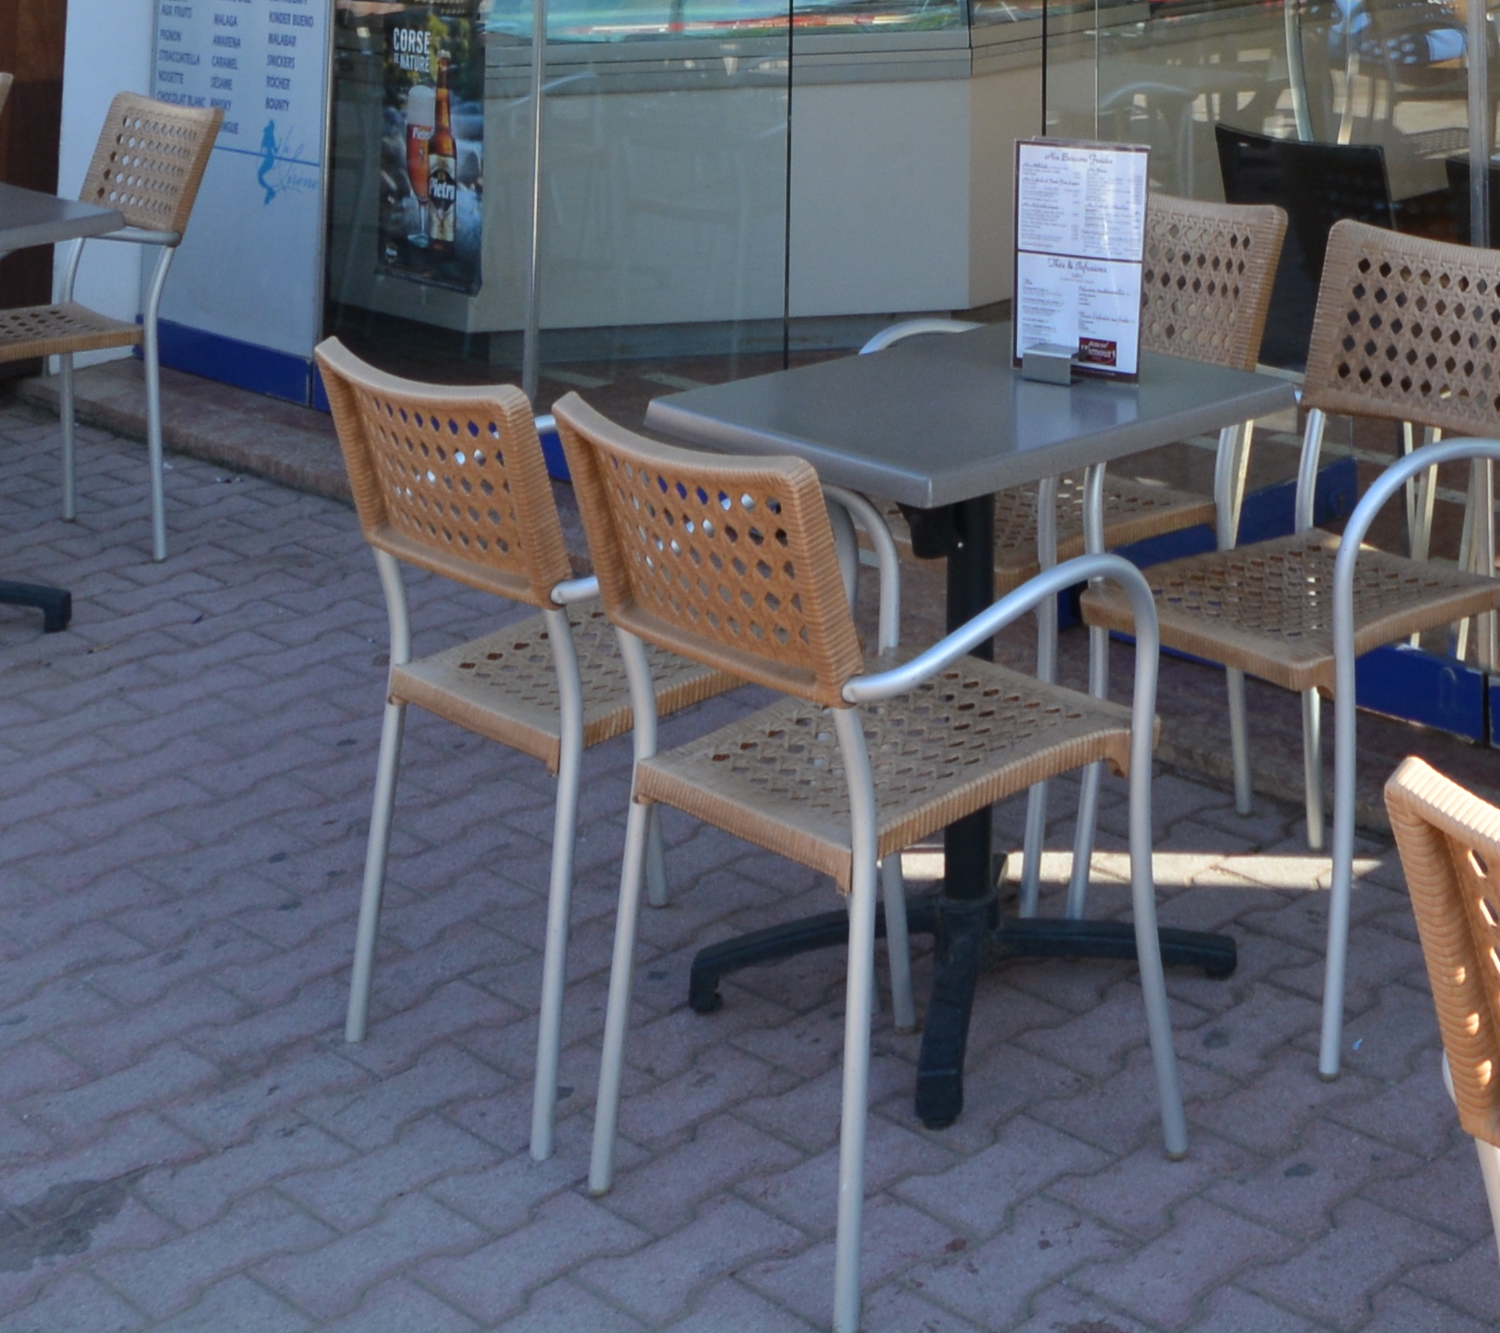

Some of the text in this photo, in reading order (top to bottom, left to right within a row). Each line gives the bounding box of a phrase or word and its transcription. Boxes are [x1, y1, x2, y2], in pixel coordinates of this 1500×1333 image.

[269, 11, 291, 24] KINDER
[393, 27, 431, 54] CORSE
[267, 54, 295, 69] SNICKERS
[400, 55, 430, 73] NATURE
[266, 76, 290, 90] ROCHER
[266, 97, 289, 111] BOUNTY
